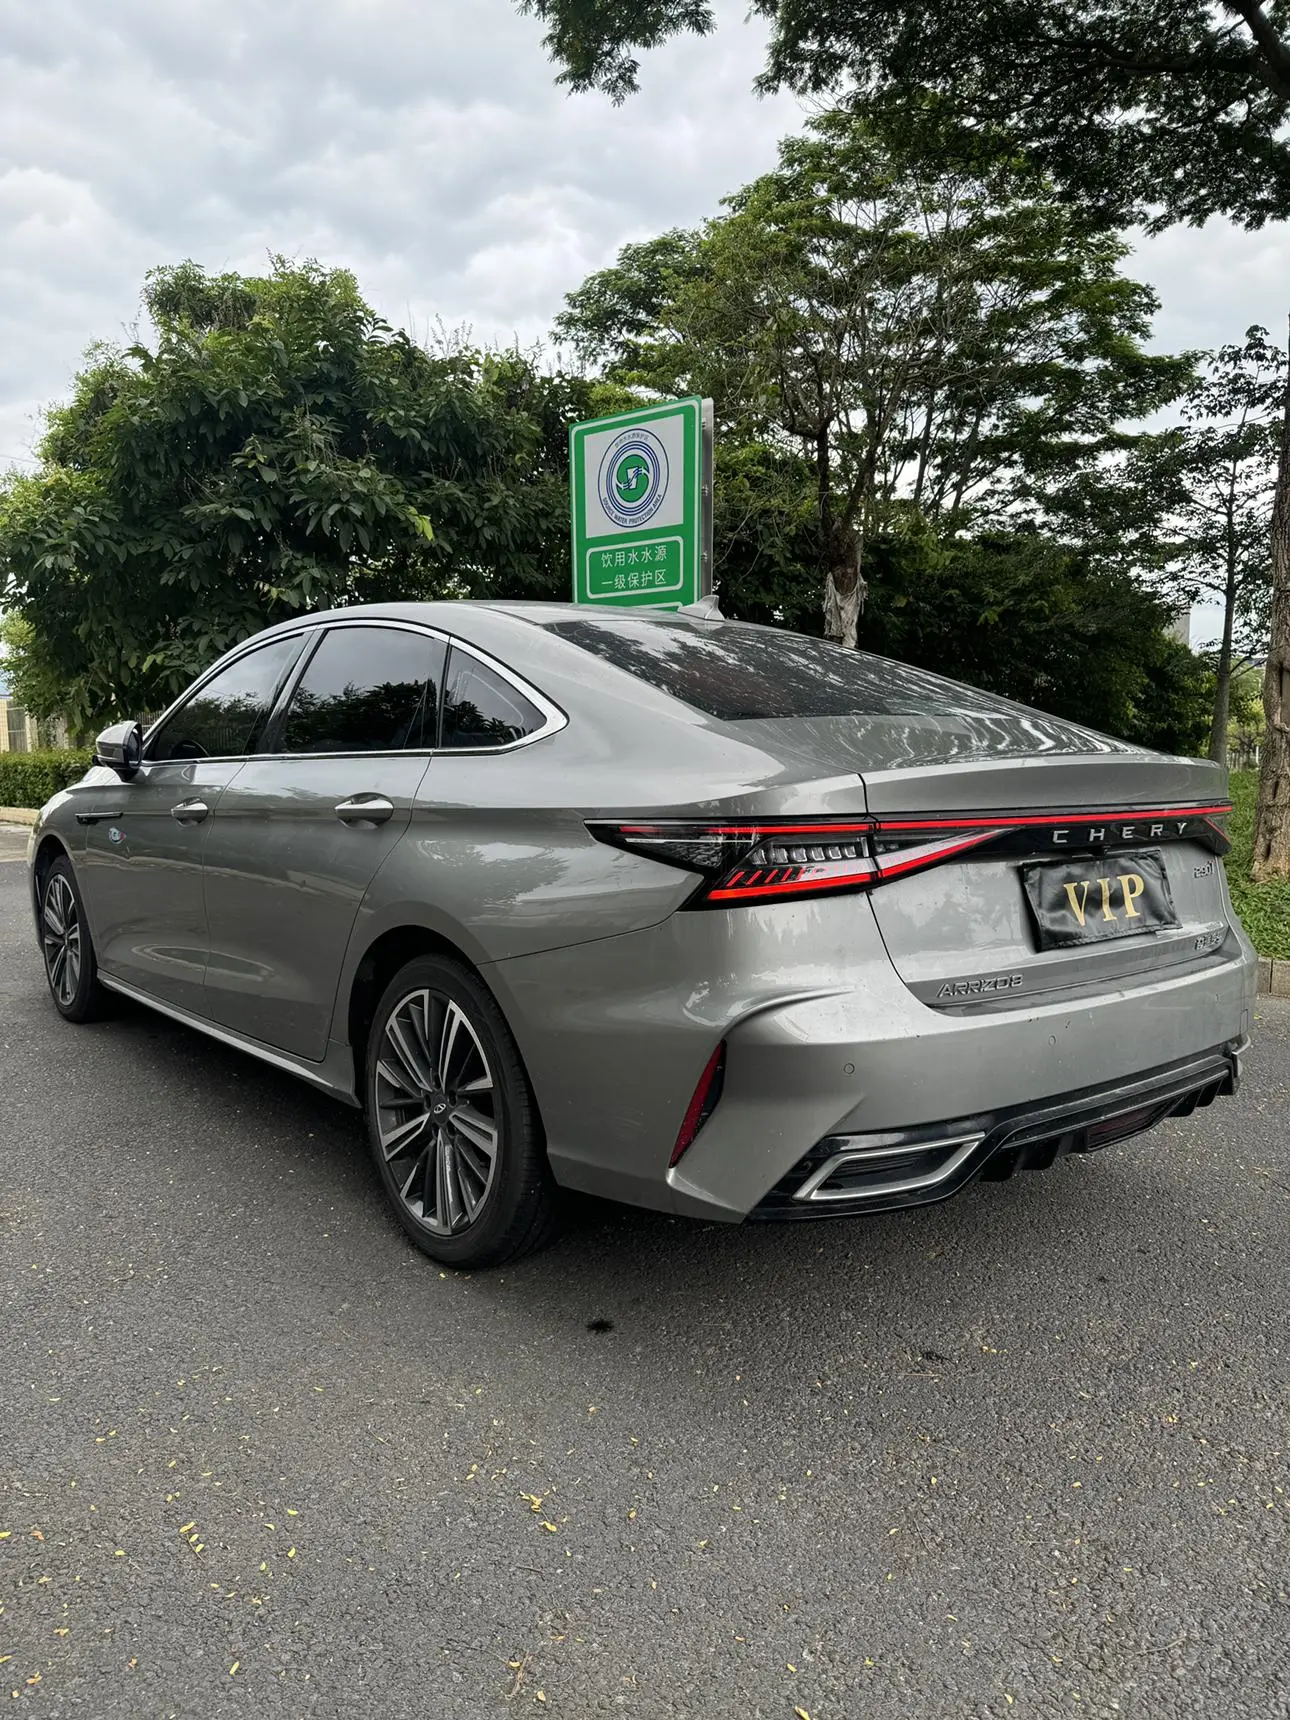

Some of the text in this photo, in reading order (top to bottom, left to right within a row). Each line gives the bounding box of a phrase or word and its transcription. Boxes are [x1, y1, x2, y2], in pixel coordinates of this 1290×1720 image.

[601, 545, 667, 568] 饮用水水源
[601, 569, 667, 589] 一级保护区
[1052, 822, 1188, 844] CHERY
[1063, 873, 1145, 926] VIP
